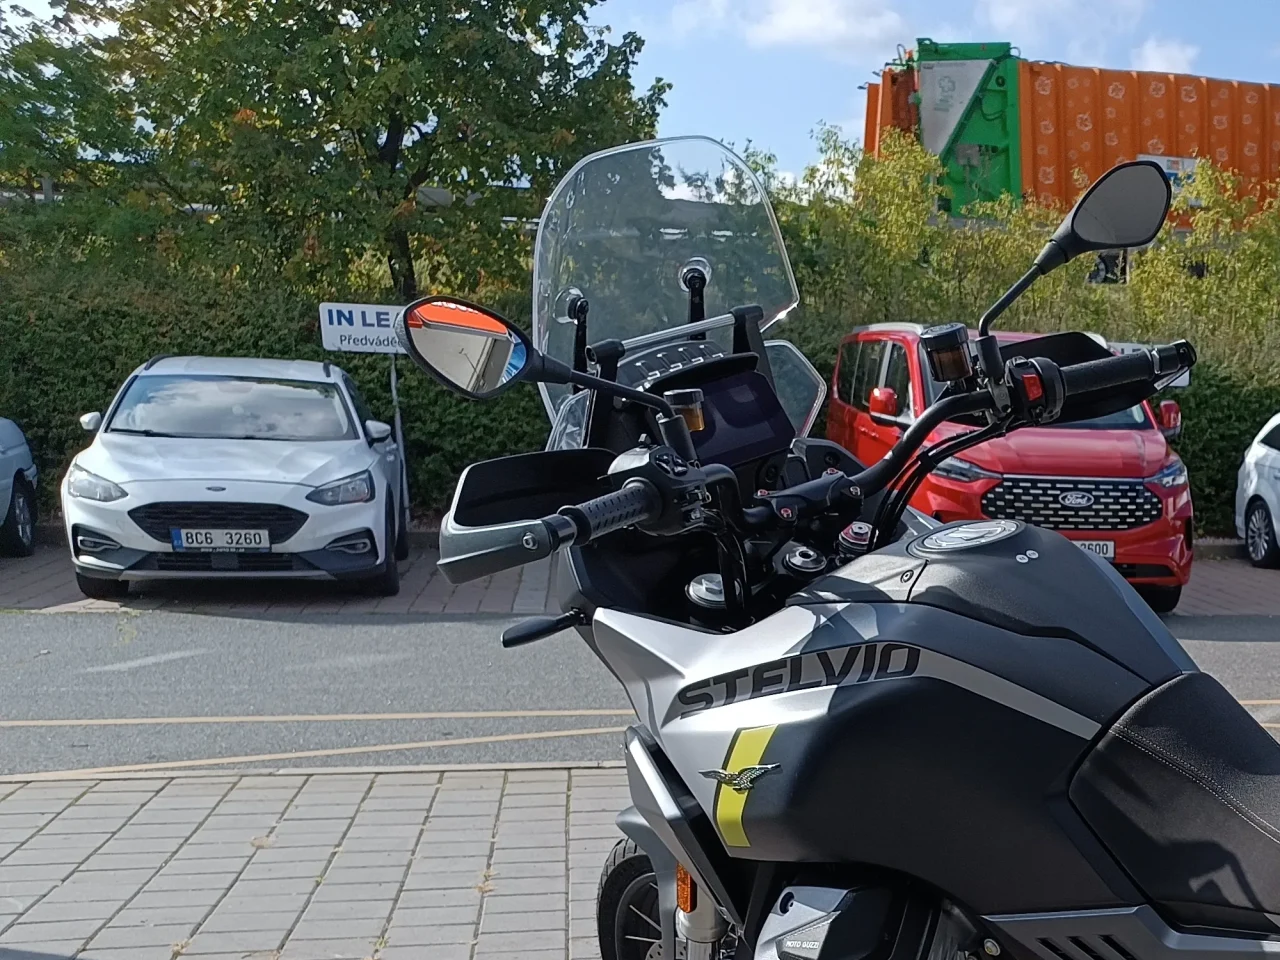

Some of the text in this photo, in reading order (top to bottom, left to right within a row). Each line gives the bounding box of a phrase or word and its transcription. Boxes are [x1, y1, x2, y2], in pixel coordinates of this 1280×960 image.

[327, 308, 400, 329] IN LE
[185, 531, 262, 546] 8C6 3260
[678, 642, 921, 720] STELVIO
[785, 940, 820, 949] MOTO GUZZI
